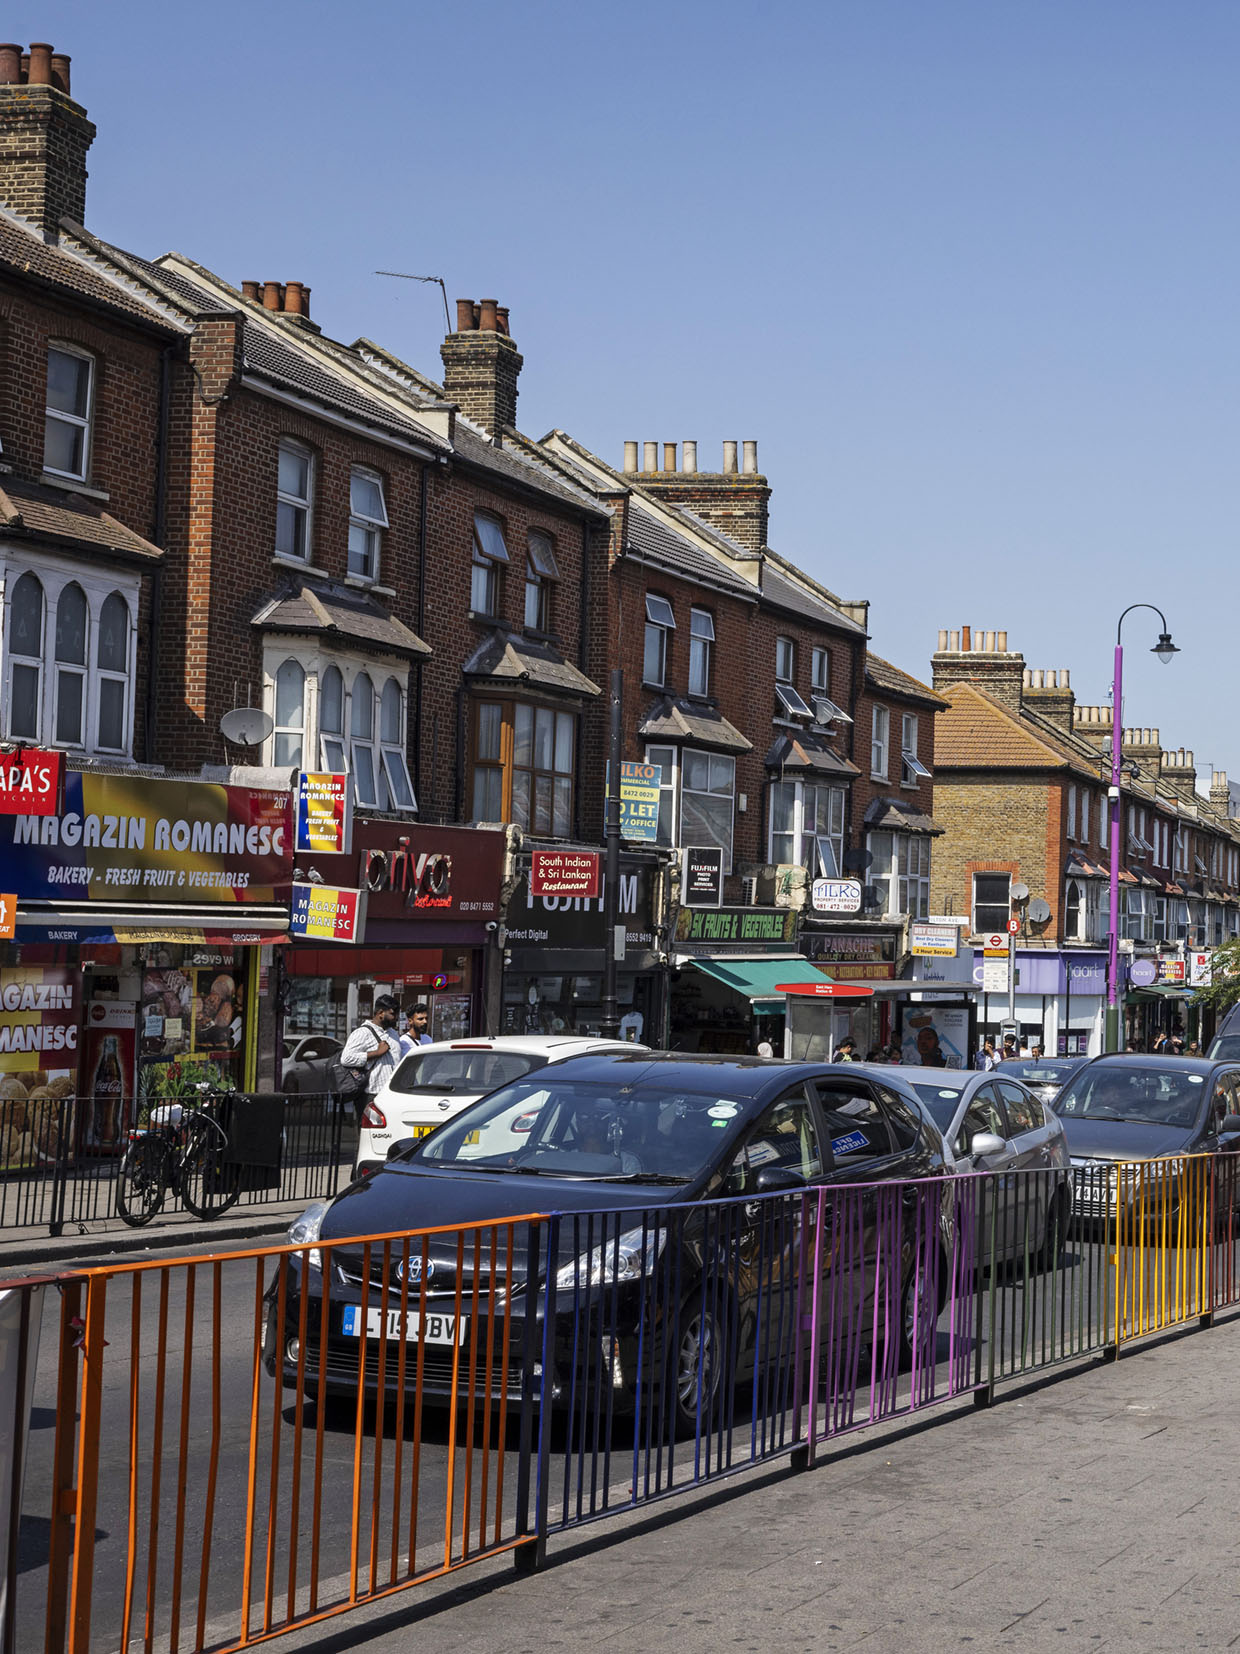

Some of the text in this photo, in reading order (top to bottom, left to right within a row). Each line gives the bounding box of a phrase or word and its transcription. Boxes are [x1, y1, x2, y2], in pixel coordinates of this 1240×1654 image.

[621, 764, 655, 778] ILKO
[273, 797, 288, 809] 207
[620, 803, 655, 817] O LET
[630, 819, 656, 827] OFFICE
[13, 812, 283, 856] MAGAZIN ROMANESC
[539, 856, 591, 867] South Indian
[47, 866, 94, 885] BAKERY
[105, 868, 141, 886] FRESH
[143, 869, 176, 887] FRUIT
[188, 871, 249, 888] VEGETABLES
[538, 869, 591, 879] & Sri Lankan
[542, 881, 588, 891] Restaurant
[814, 884, 860, 898] TILKO
[299, 899, 348, 914] MAGAZIN
[460, 902, 469, 910] 020
[292, 913, 351, 929] ROMANESC
[703, 913, 731, 938] FRUITS
[741, 914, 784, 938] VEGETABLES
[1010, 921, 1018, 931] B
[48, 931, 78, 940] BAKERY
[505, 929, 548, 941] Perfect Digital
[824, 937, 875, 952] PANACHE
[1133, 969, 1152, 977] haart
[0, 984, 73, 1011] GAZIN
